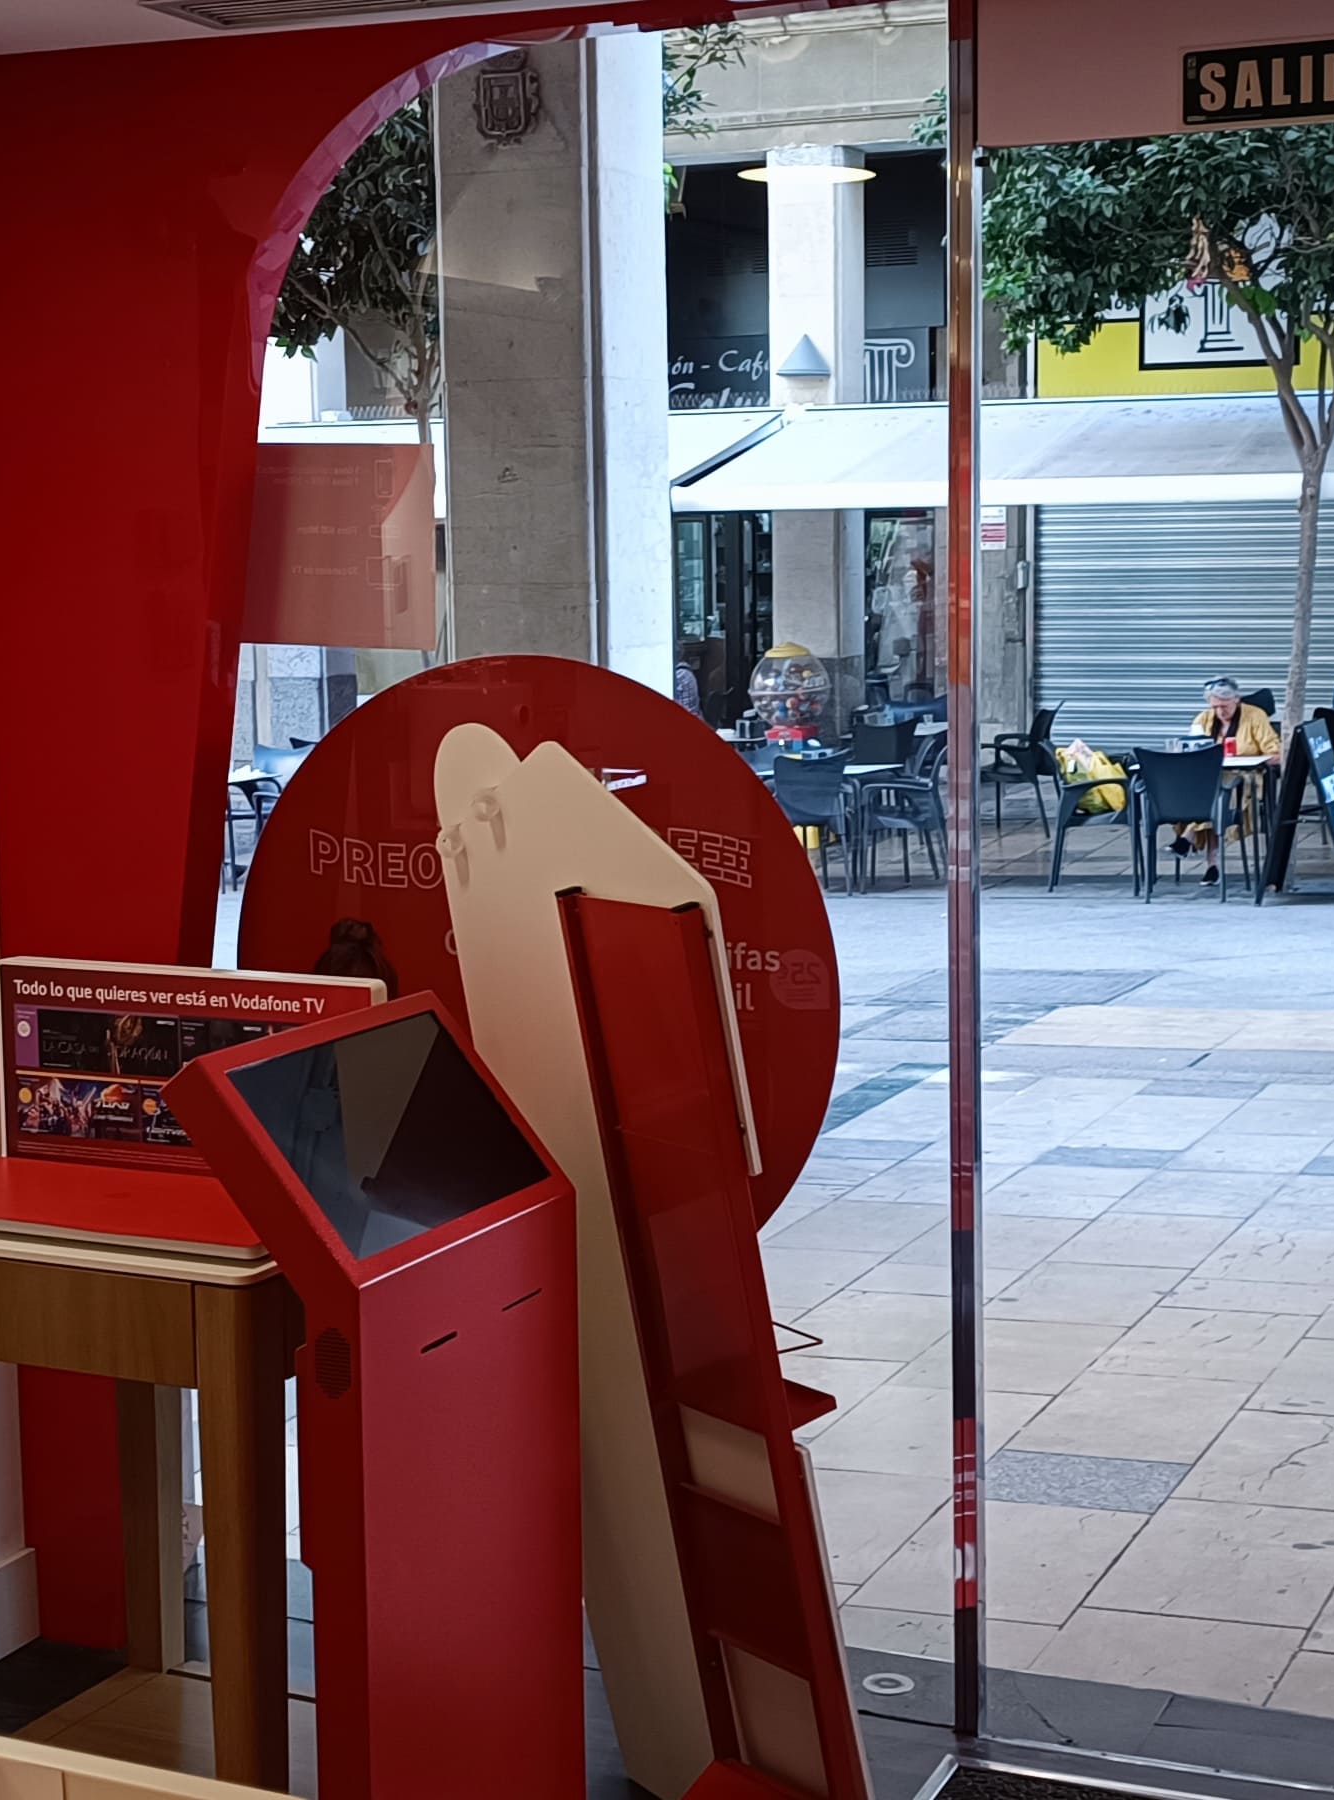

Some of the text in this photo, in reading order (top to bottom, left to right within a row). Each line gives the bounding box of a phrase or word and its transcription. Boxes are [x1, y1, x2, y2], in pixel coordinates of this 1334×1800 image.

[669, 356, 694, 375] ón
[725, 942, 780, 972] ifas
[12, 979, 325, 1014] Todo lo que quieres ver está en Vodafone TV
